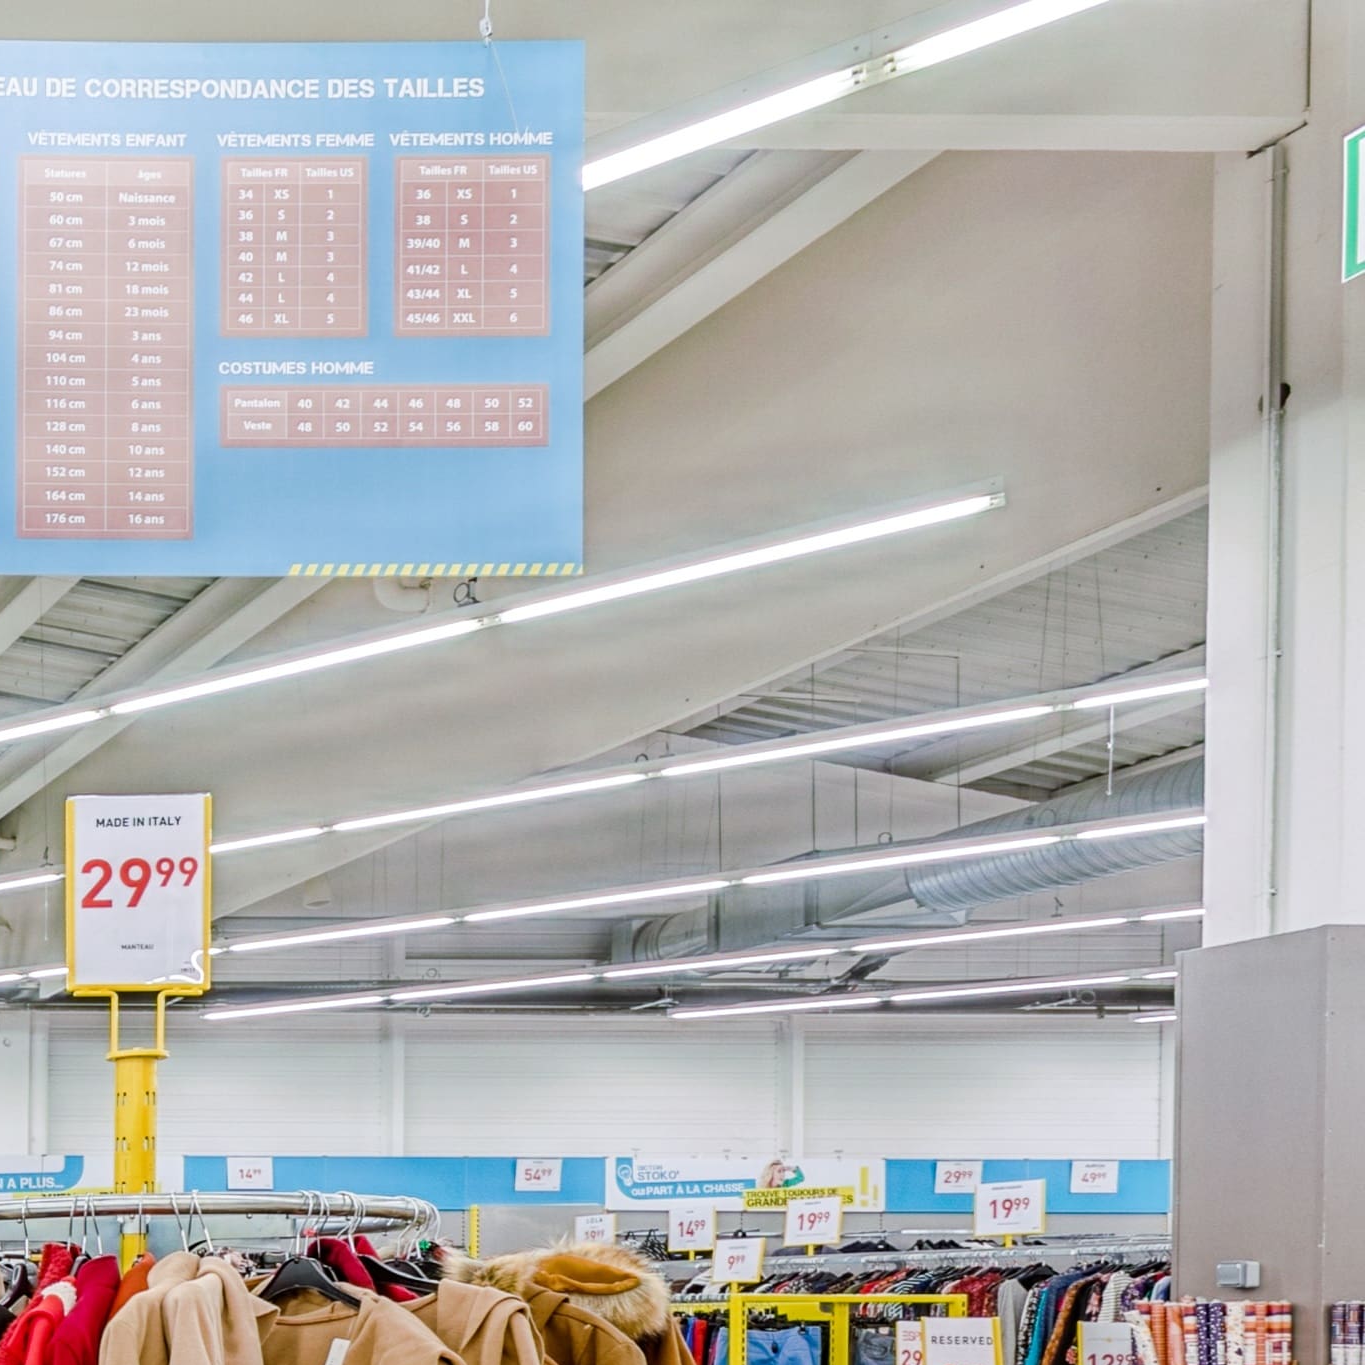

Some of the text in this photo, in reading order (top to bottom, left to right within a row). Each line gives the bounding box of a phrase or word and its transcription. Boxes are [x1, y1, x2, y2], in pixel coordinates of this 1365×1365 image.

[45, 77, 76, 98] DE
[85, 79, 319, 99] CORRESPONDANCE
[327, 79, 375, 98] DES
[385, 78, 484, 98] TAILLES
[28, 130, 187, 147] VÊTEMENTS ENFANT
[217, 131, 375, 147] VÊTEMENTS FEMME
[389, 130, 553, 146] VÊTEMENTS HOMME
[45, 168, 86, 178] Statures
[241, 168, 288, 177] Tailles FR
[306, 168, 353, 177] Tailles US
[419, 166, 467, 175] Tailles FR
[489, 165, 537, 174] Tailles US
[119, 193, 175, 203] Naissance
[407, 238, 440, 249] 39/40
[406, 265, 440, 275] 41/42
[406, 289, 440, 299] 43/44
[457, 289, 471, 298] XL
[406, 313, 440, 323] 45/46
[453, 313, 476, 322] XXL
[219, 362, 374, 375] COSTUMES HOMME
[234, 399, 533, 408] Pantalon 40 42 44 46 48 50 52
[243, 421, 532, 432] Veste 48 50 52 54 56 58 60
[46, 514, 66, 523] 176
[96, 816, 181, 828] MADE IN ITALY
[81, 857, 198, 908] 2999
[944, 1171, 973, 1183] 2999
[7, 1179, 16, 1189] A
[646, 1187, 672, 1196] PART
[686, 1186, 699, 1194] LA
[704, 1184, 744, 1193] CHASSE
[989, 1198, 1029, 1219] 1999
[797, 1212, 830, 1231] 1999
[678, 1220, 706, 1237] 1499
[931, 1336, 993, 1345] RESERVED
